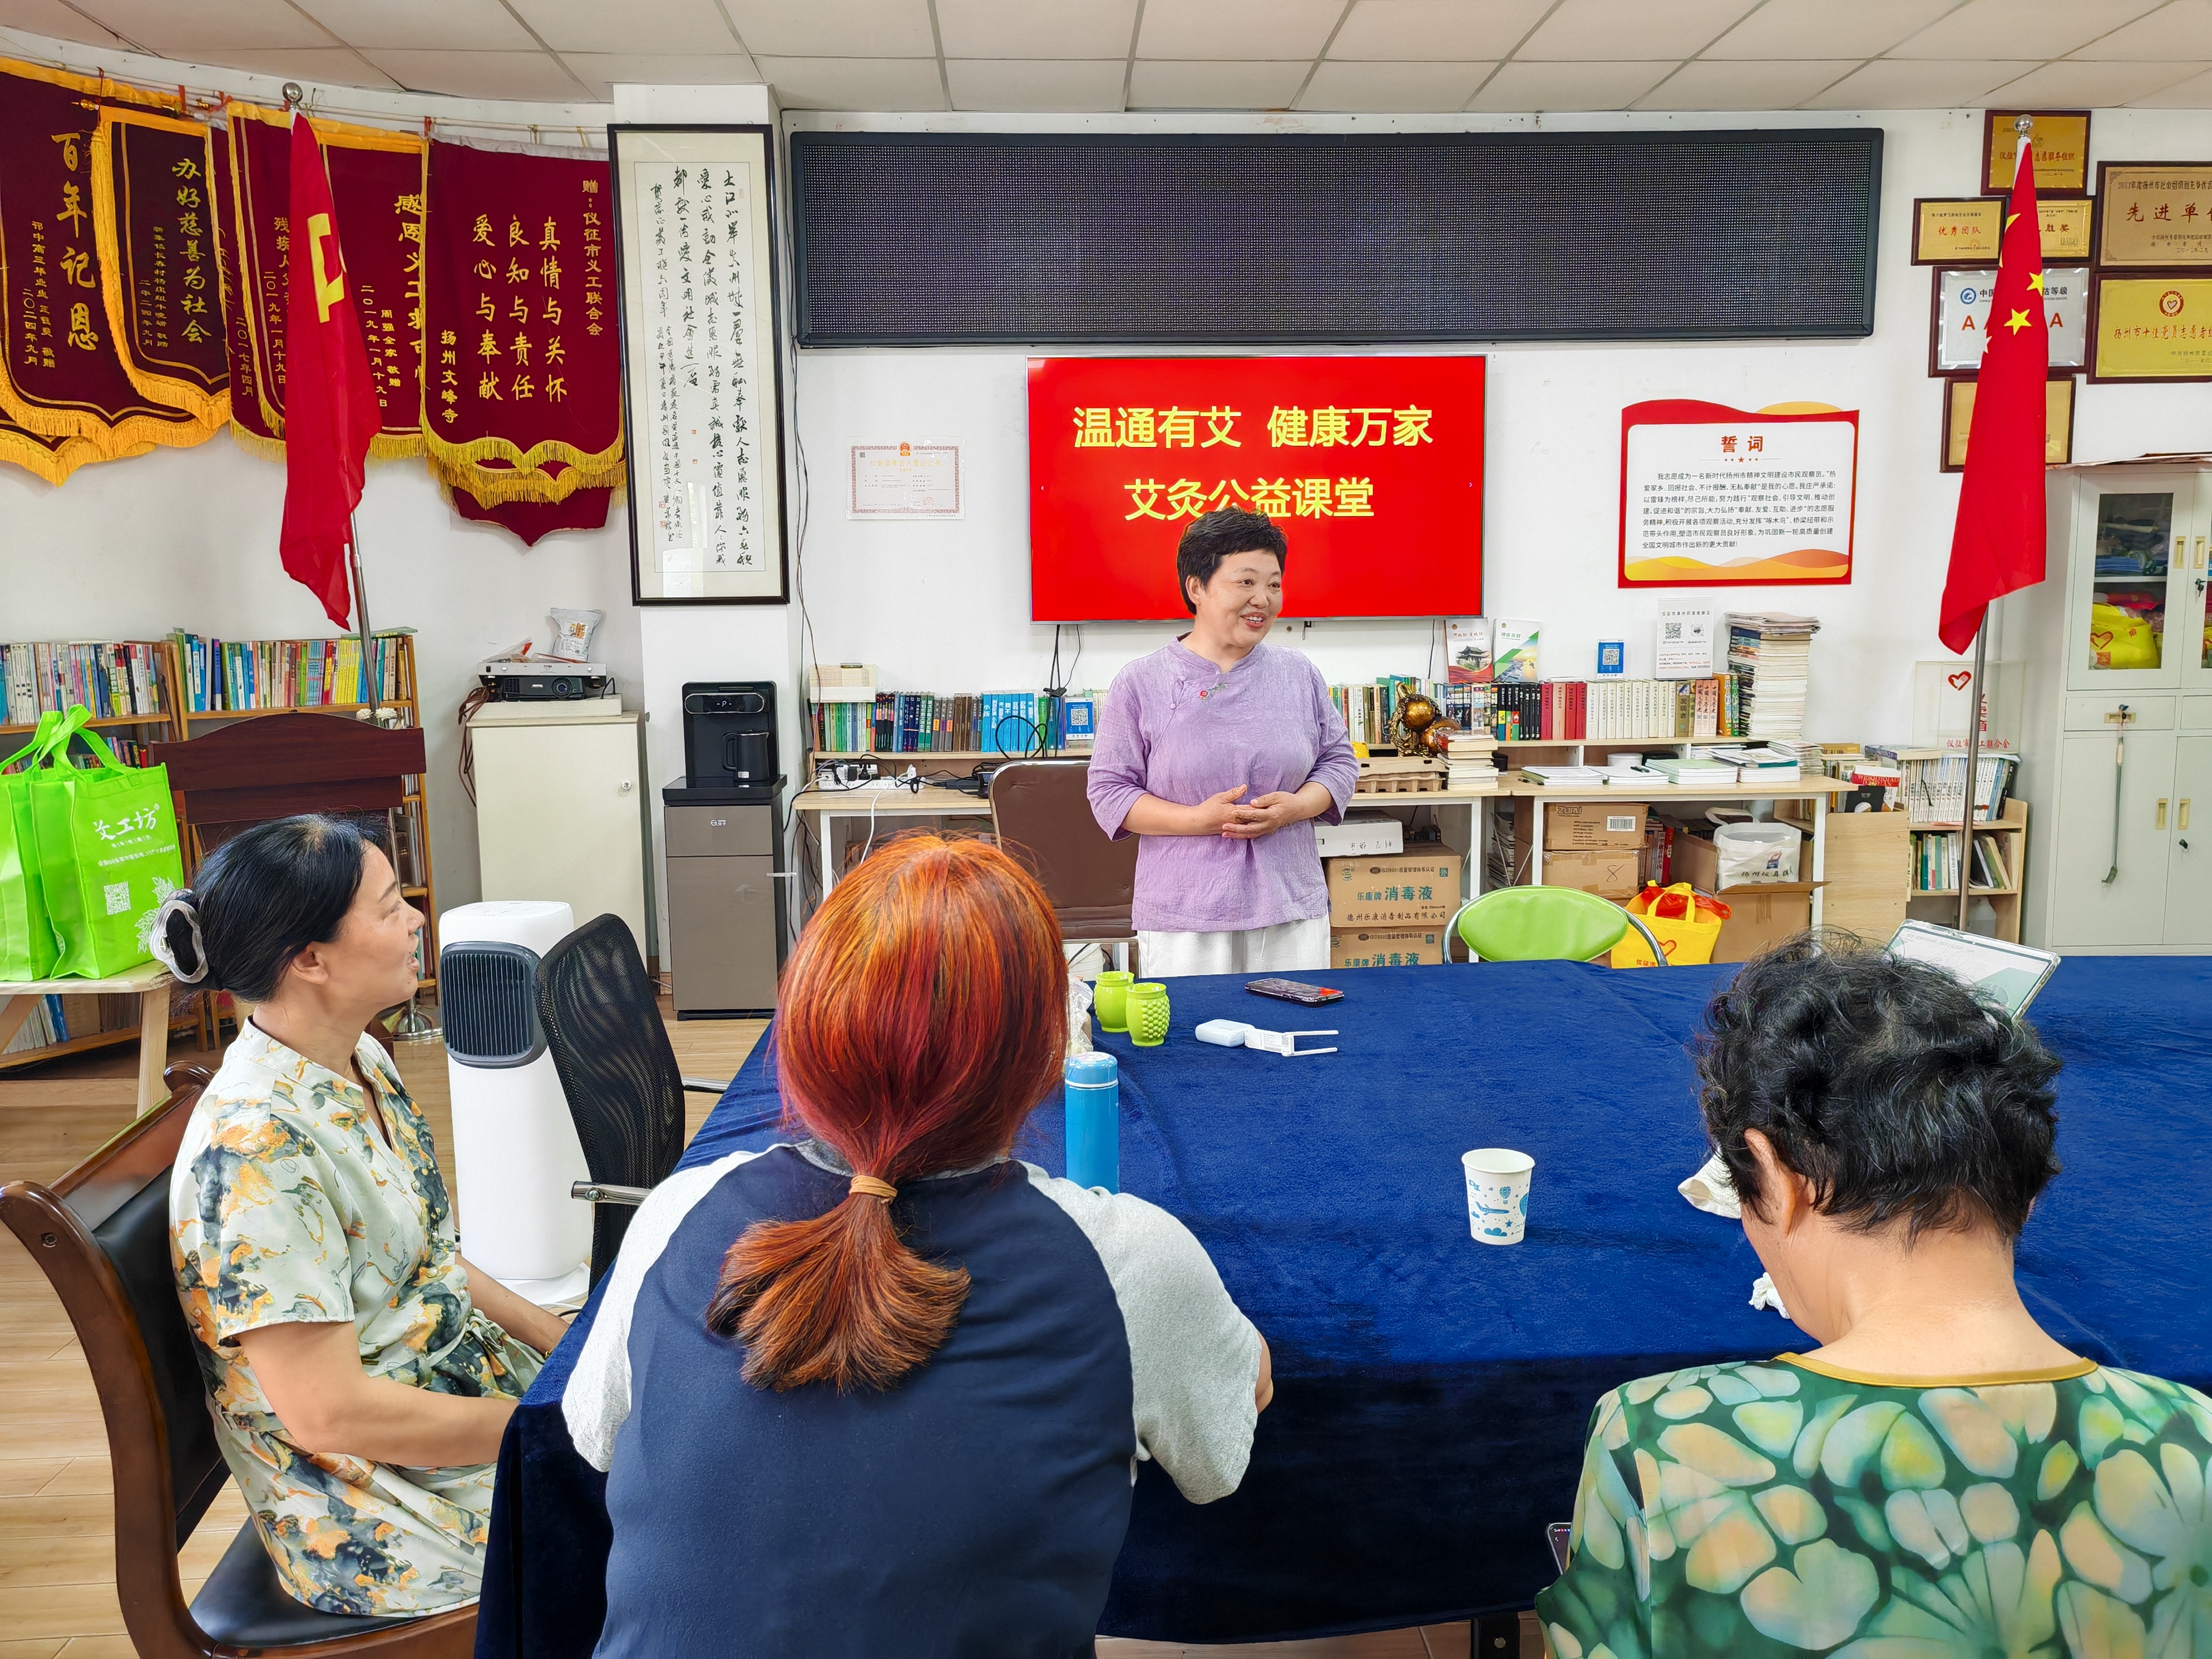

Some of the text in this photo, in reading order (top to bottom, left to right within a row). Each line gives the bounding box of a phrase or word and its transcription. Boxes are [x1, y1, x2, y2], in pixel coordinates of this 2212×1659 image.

[51, 131, 99, 351] 百年记恩
[1939, 226, 1981, 236] 优秀团队
[2039, 224, 2069, 233] 胜奖
[172, 158, 211, 345] 办好慈善为社会
[472, 213, 503, 401] 爱心与奉献
[506, 214, 535, 401] 良知与责任
[539, 216, 568, 403] 真情与关怀
[1961, 315, 1975, 331] A
[2049, 313, 2063, 327] A
[441, 329, 458, 423] 扬州文峰寺
[1073, 404, 1433, 448] 温通有艾 健康万家
[1721, 436, 1763, 453] 誓词
[1124, 477, 1374, 521] 艾灸公益课堂
[1357, 886, 1432, 901] 乐康牌 消毒液
[1372, 953, 1419, 967] 消毒液
